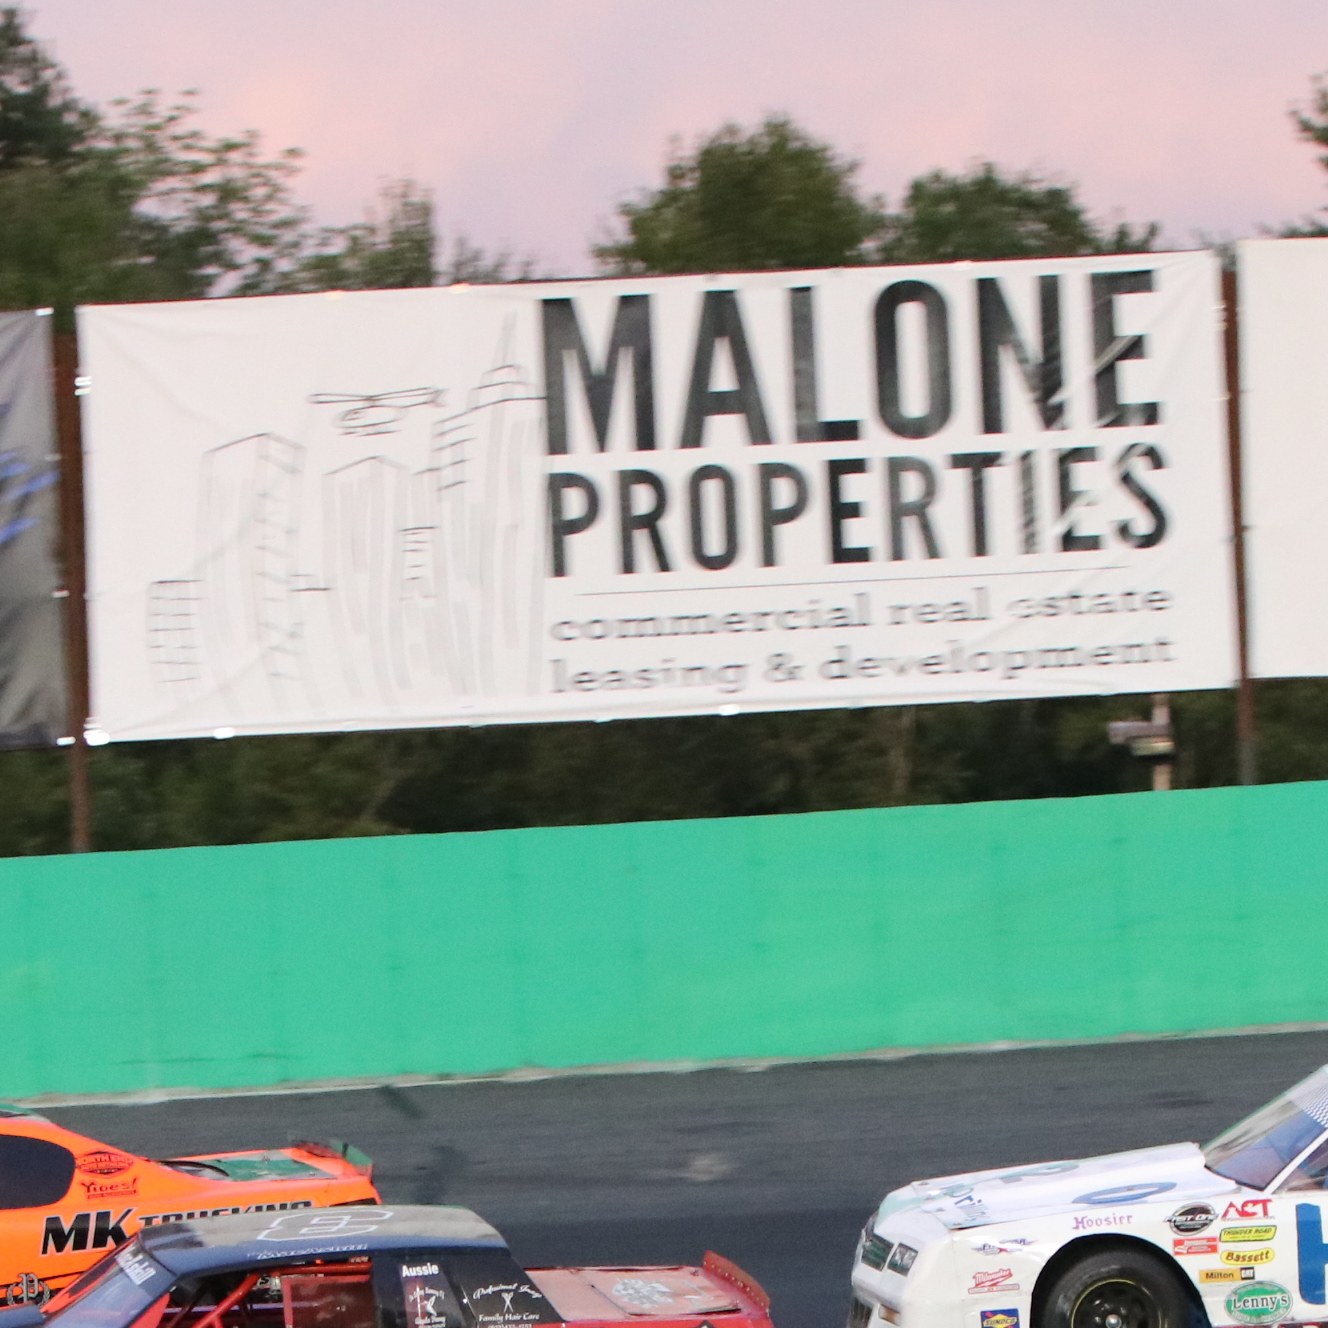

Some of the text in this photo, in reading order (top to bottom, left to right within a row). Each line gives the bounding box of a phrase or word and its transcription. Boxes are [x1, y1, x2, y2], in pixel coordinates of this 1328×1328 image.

[540, 270, 1159, 455] MALONE
[546, 443, 1171, 578] PROPERTIES
[550, 585, 1172, 642] commercial real estate
[549, 636, 1178, 694] leasing & development
[40, 1207, 138, 1257] MK
[1226, 1250, 1270, 1263] Bassett
[402, 1262, 440, 1278] Aussie
[1205, 1272, 1234, 1280] Milton
